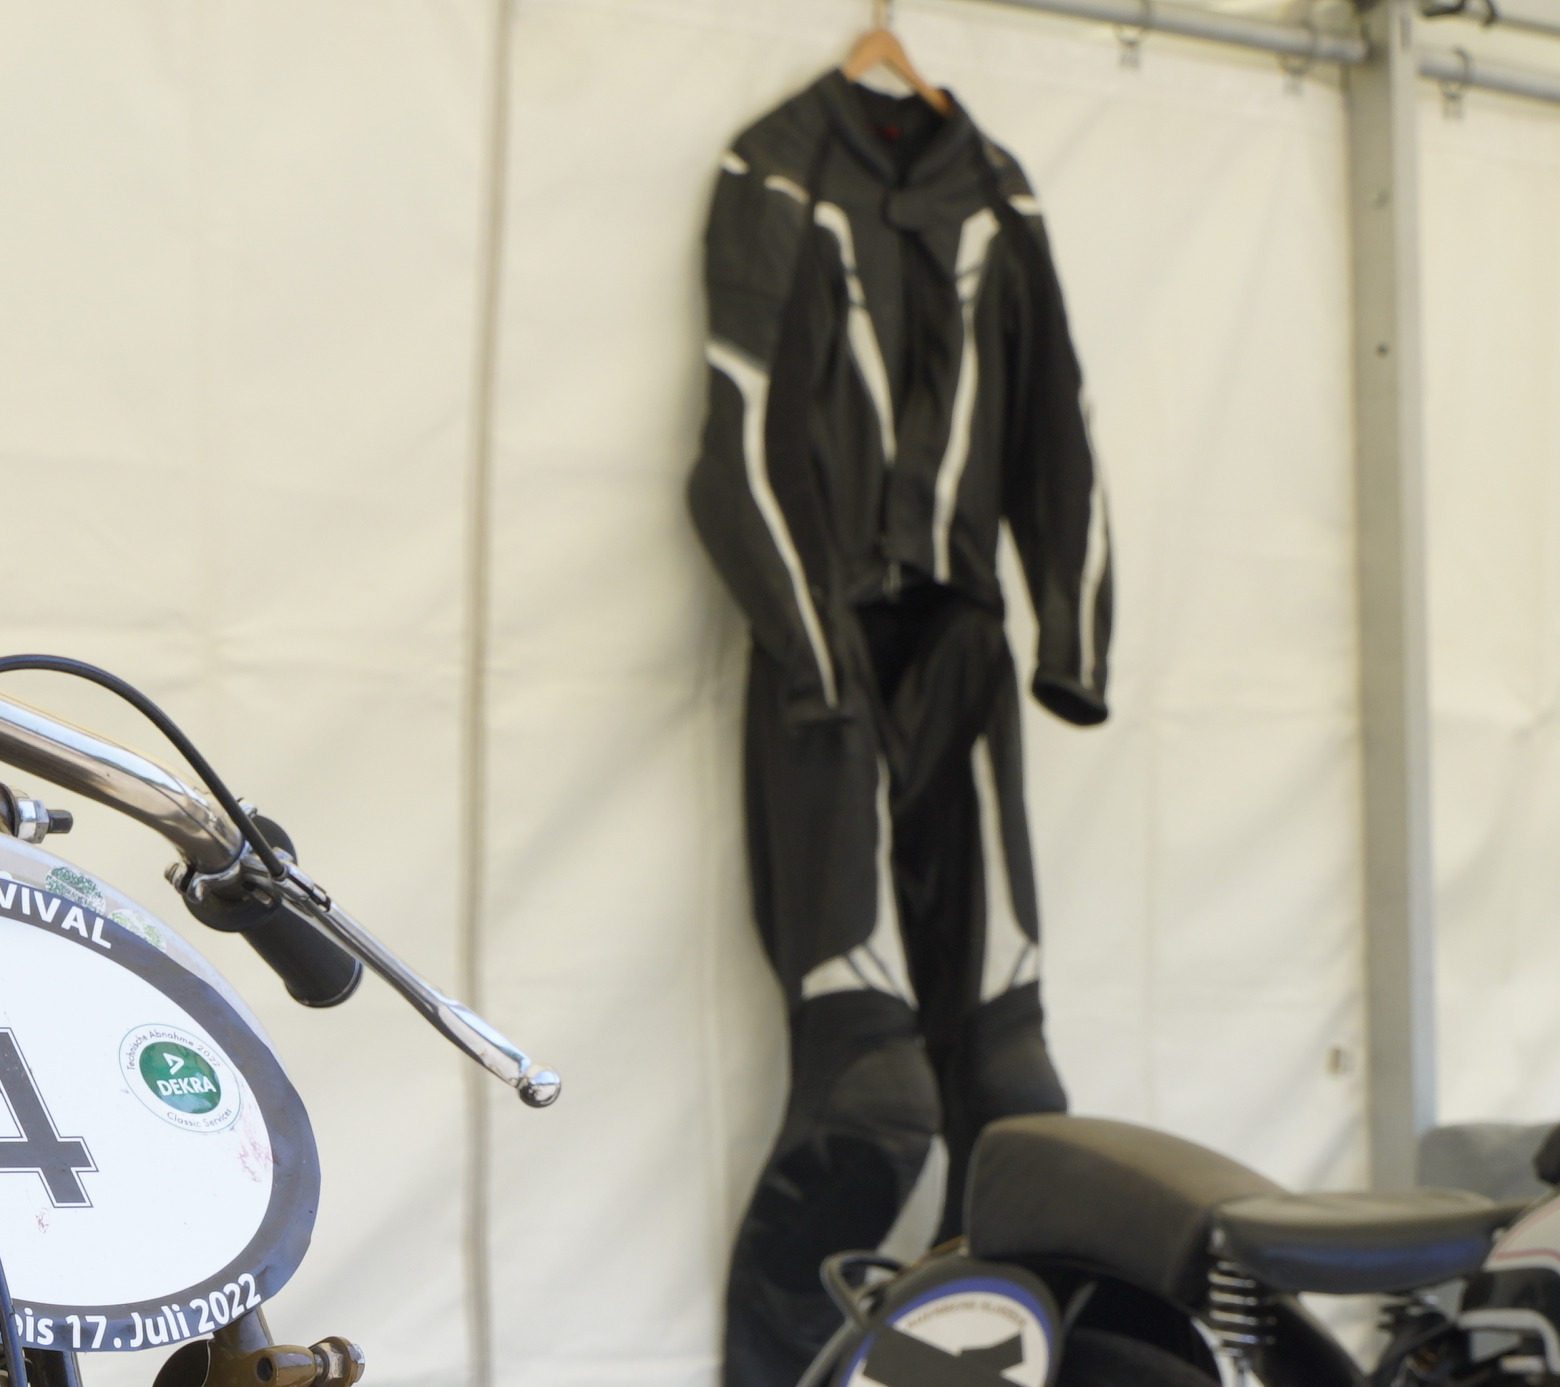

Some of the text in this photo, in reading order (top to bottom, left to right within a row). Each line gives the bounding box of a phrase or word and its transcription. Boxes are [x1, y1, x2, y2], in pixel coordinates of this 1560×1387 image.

[125, 1028, 221, 1071] Technische Abnahme 2022
[156, 1075, 217, 1096] DEKRA
[166, 1108, 233, 1128] Classic Services
[66, 1314, 123, 1350] 17.
[129, 1304, 191, 1348] Juli
[189, 1272, 262, 1334] 2022
